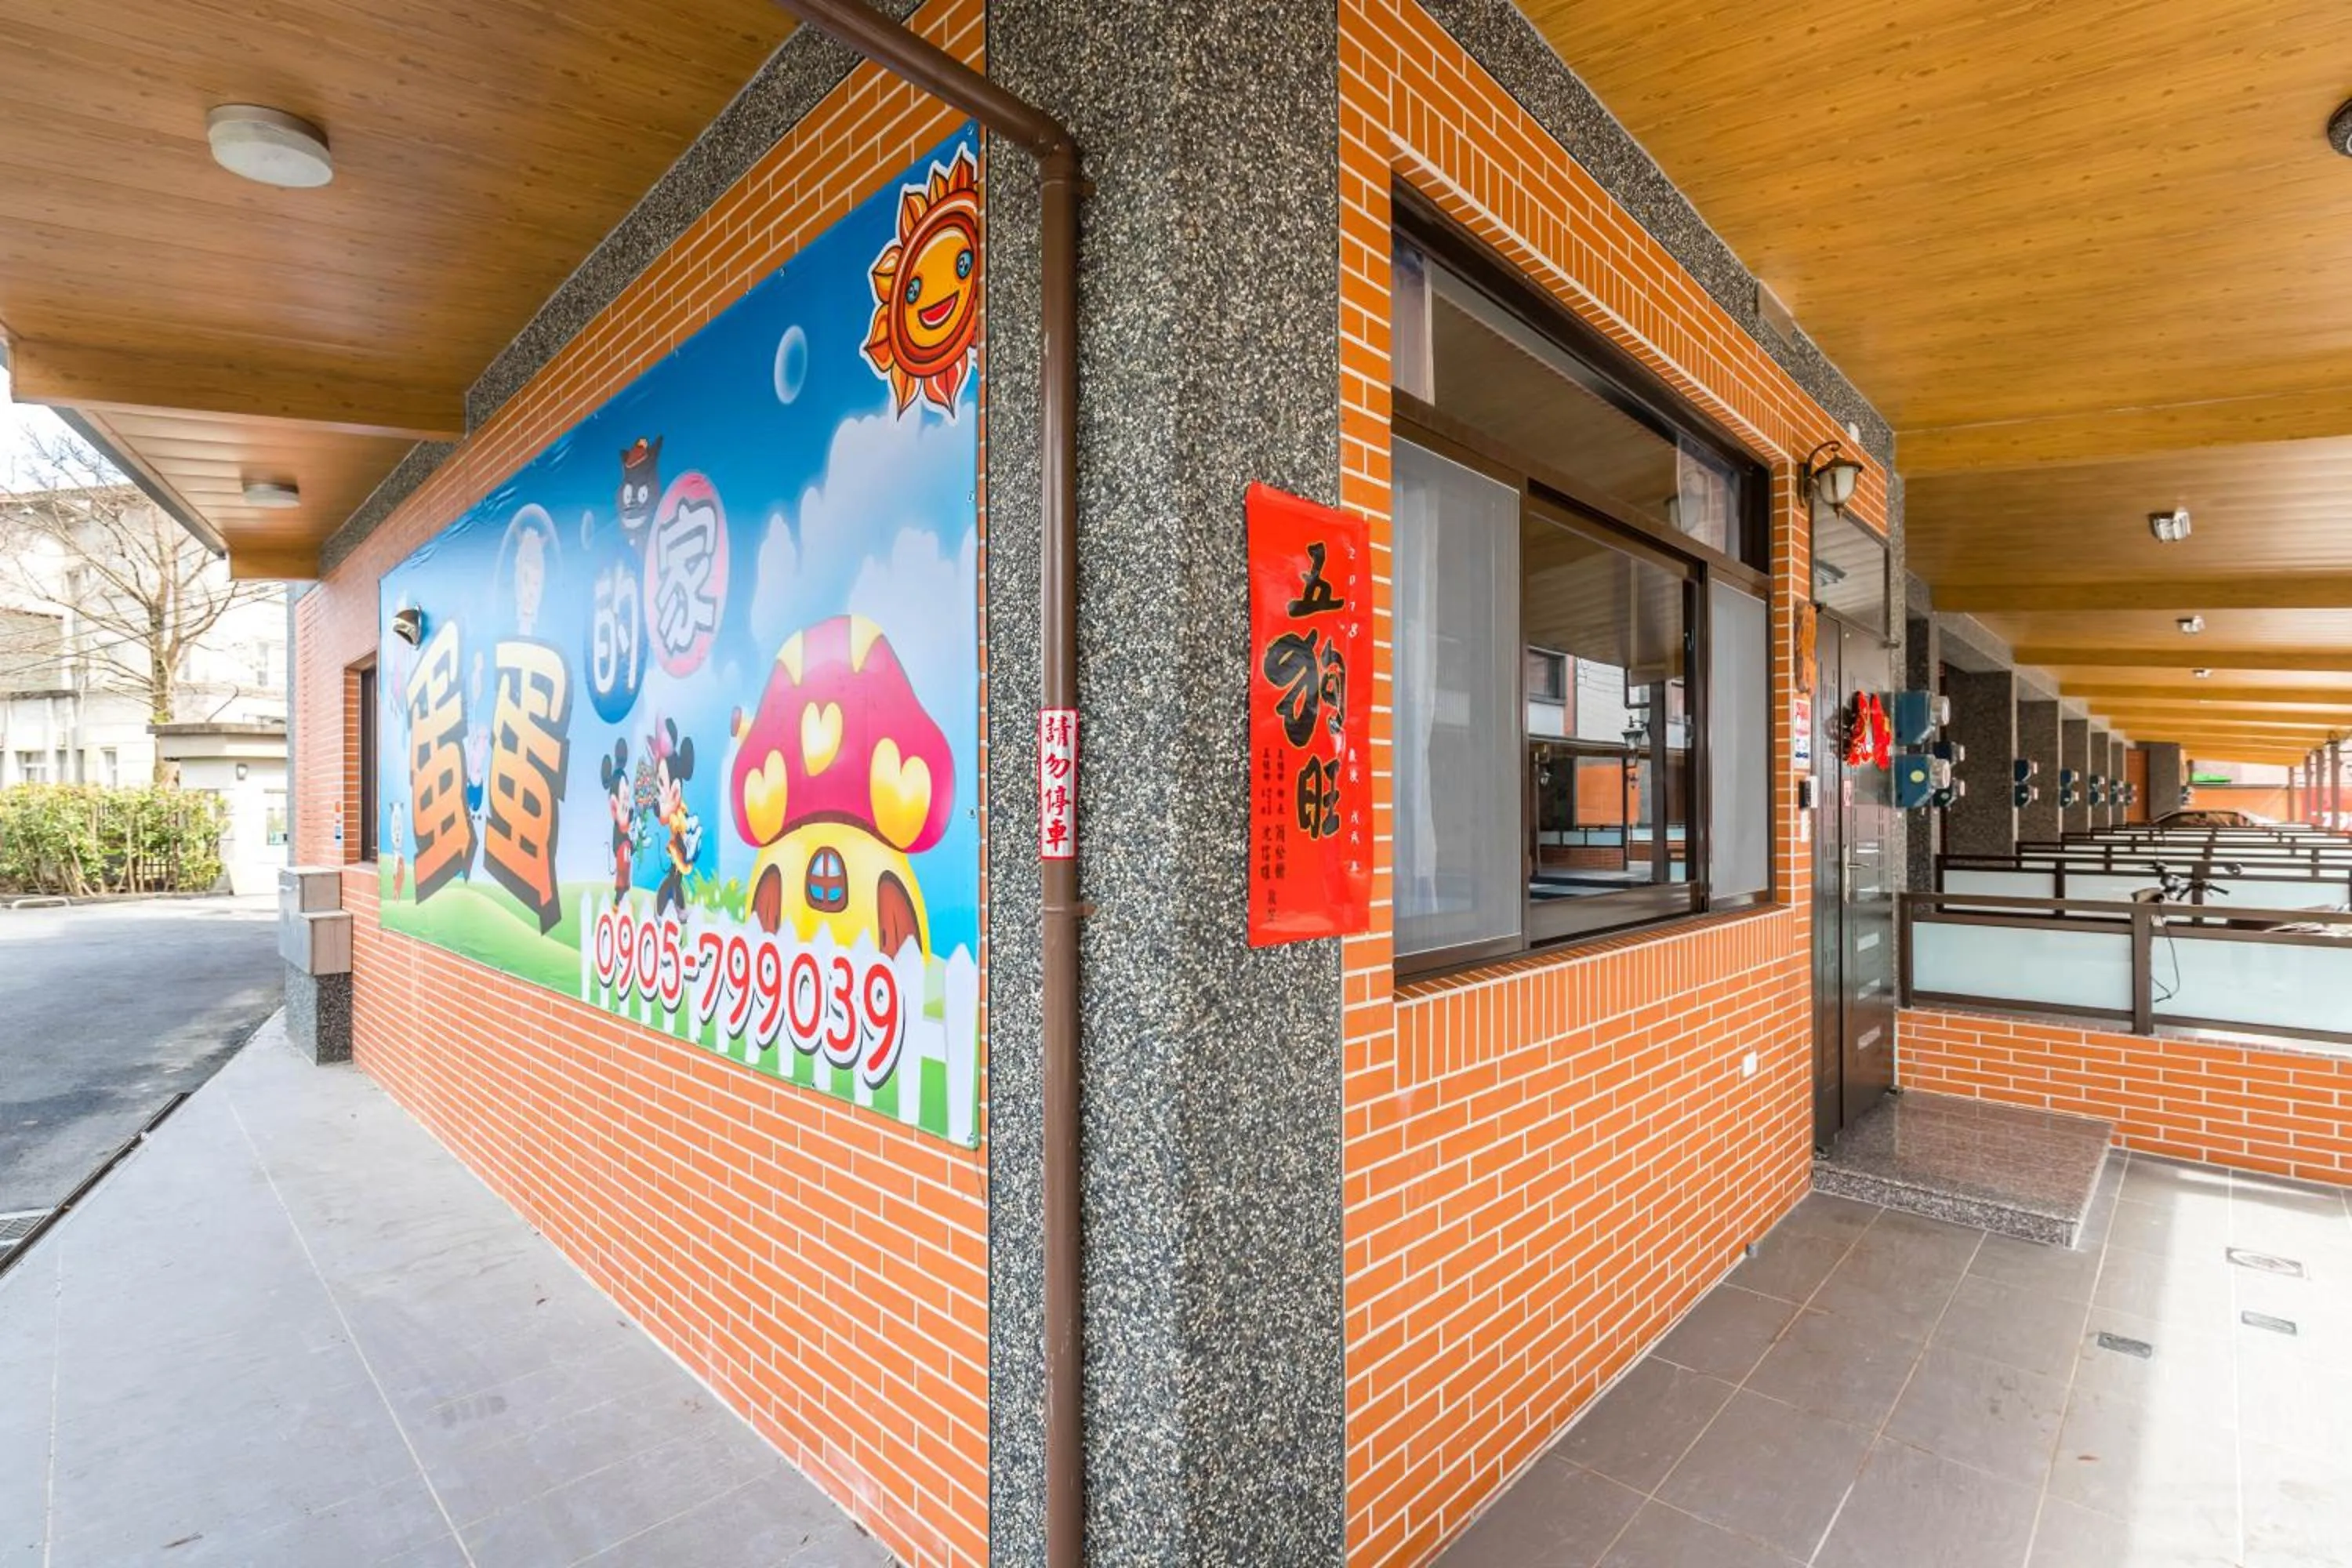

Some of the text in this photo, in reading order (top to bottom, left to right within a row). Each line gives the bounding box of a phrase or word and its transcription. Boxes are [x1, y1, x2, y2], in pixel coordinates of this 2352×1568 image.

[1263, 541, 1345, 840] 五狗旺
[1044, 715, 1072, 853] 請勿停車
[595, 913, 900, 1074] 0905-799039
